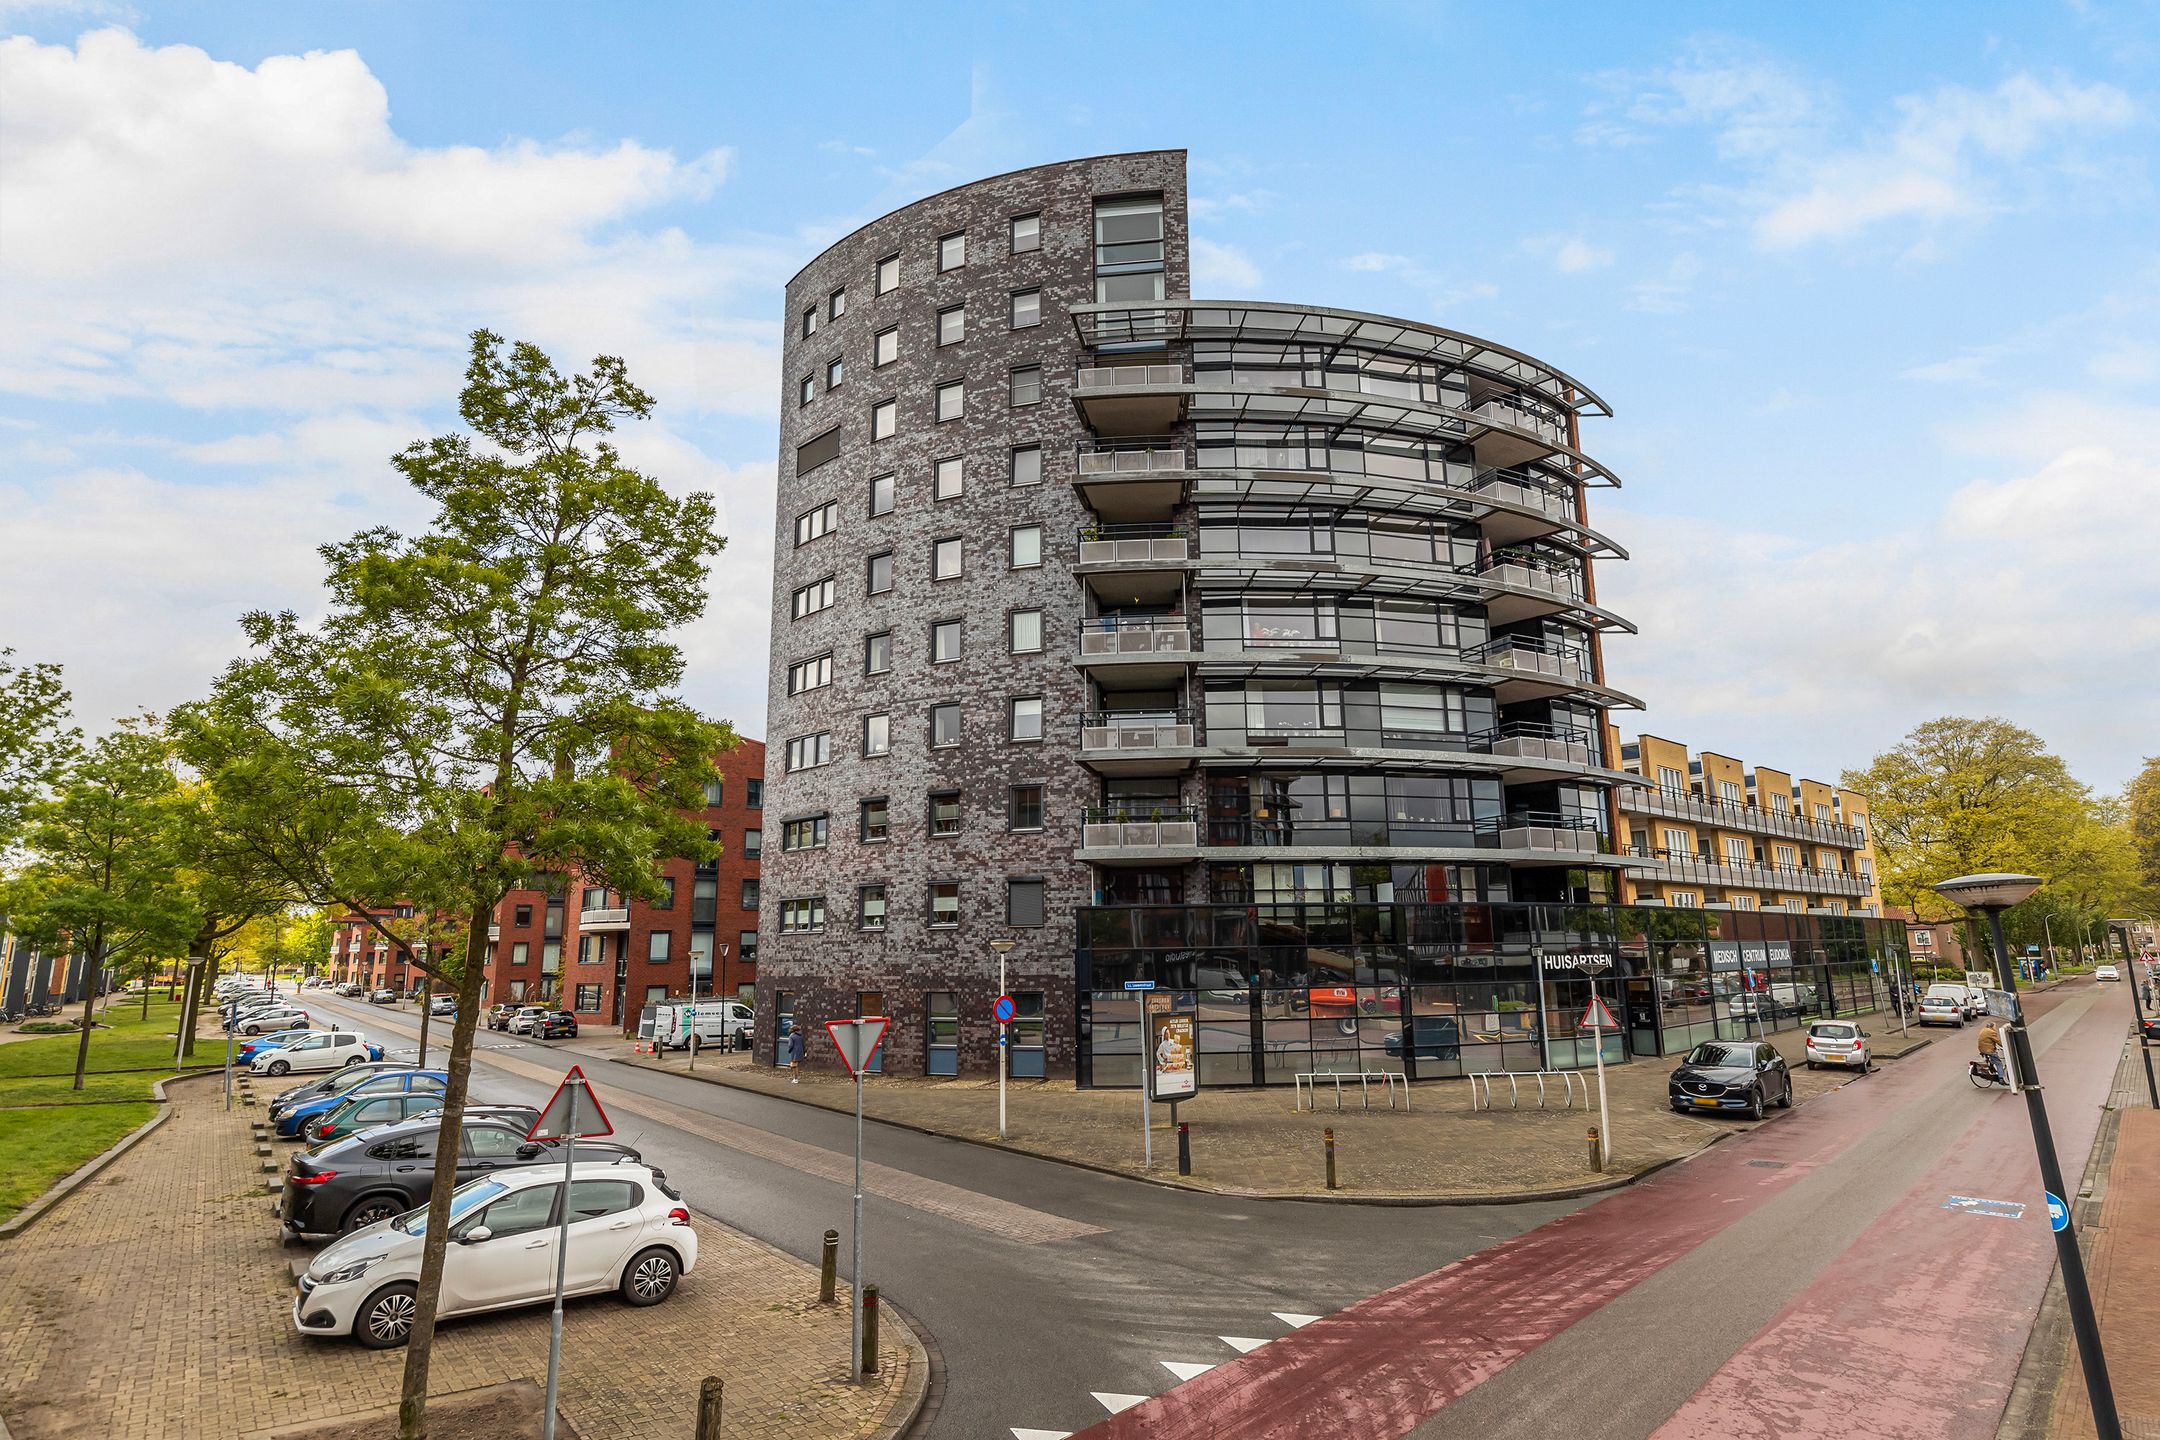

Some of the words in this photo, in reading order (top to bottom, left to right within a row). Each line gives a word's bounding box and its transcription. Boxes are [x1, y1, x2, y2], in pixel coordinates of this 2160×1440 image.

[1544, 954, 1613, 970] HUISARTSEN
[1713, 950, 1738, 963] MEDISCH
[1742, 949, 1767, 962] CENTRUM
[1769, 948, 1791, 961] EUDOKIA
